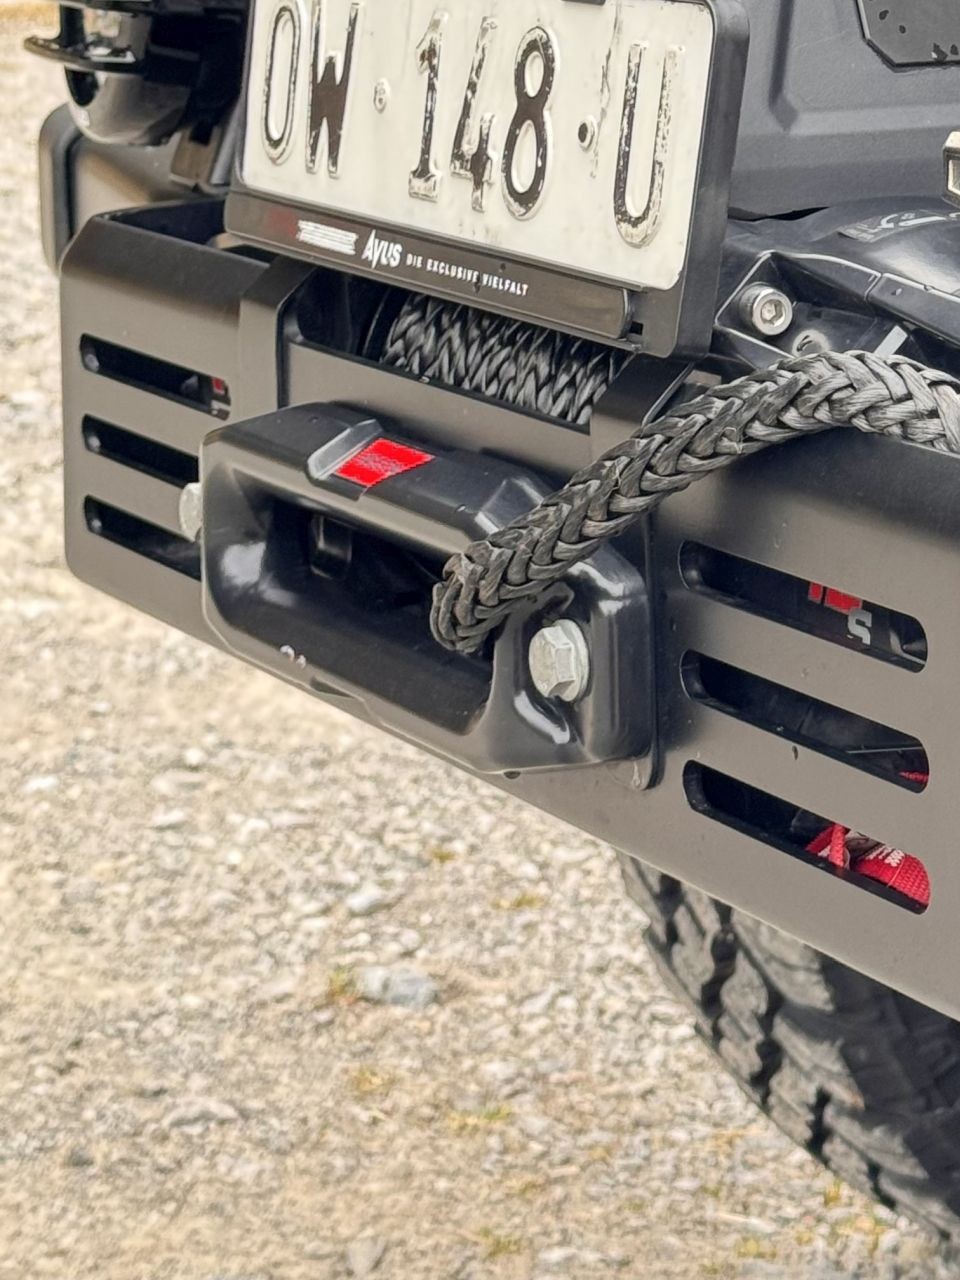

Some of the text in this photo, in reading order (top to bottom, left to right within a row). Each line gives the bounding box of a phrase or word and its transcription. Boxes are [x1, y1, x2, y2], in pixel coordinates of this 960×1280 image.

[407, 11, 559, 221] 148
[613, 40, 685, 248] U
[405, 253, 423, 269] DIE
[426, 258, 480, 284] EXCLUSIVE
[482, 272, 529, 297] VIELFALT
